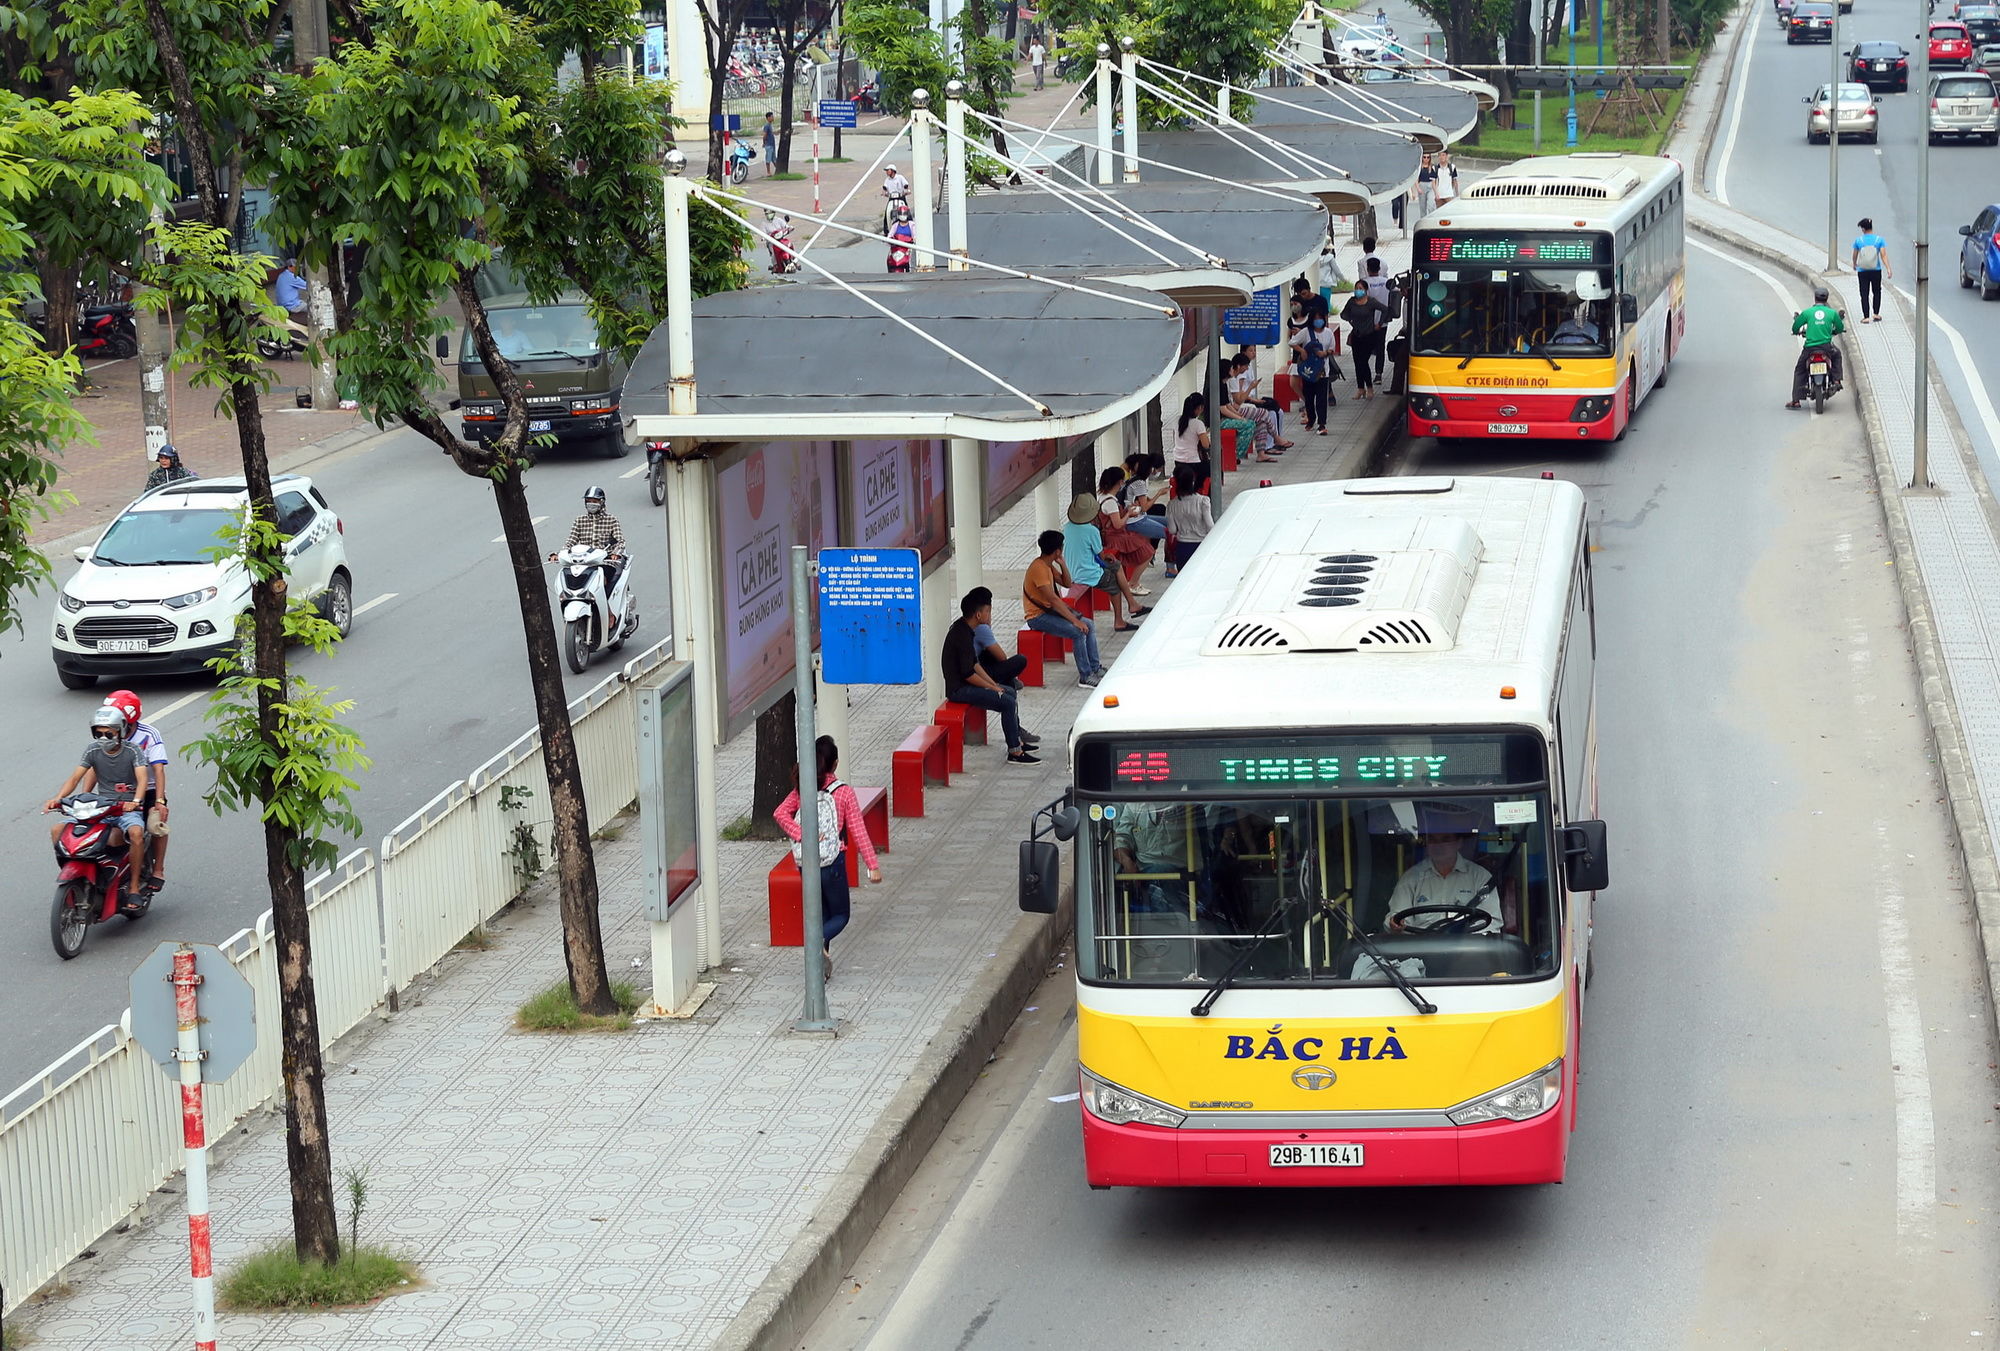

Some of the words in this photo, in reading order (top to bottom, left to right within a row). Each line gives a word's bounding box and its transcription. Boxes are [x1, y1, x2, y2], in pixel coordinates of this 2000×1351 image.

[1431, 238, 1452, 260] 07
[860, 554, 877, 562] TRÌNH
[1117, 752, 1170, 781] 45
[1220, 758, 1339, 780] TIMES
[1357, 756, 1447, 778] CITY
[1224, 1024, 1323, 1061] BẮC
[1337, 1027, 1408, 1061] HÀ
[1189, 1100, 1254, 1109] DAEWOO
[1272, 1147, 1360, 1164] 29B-116.41
